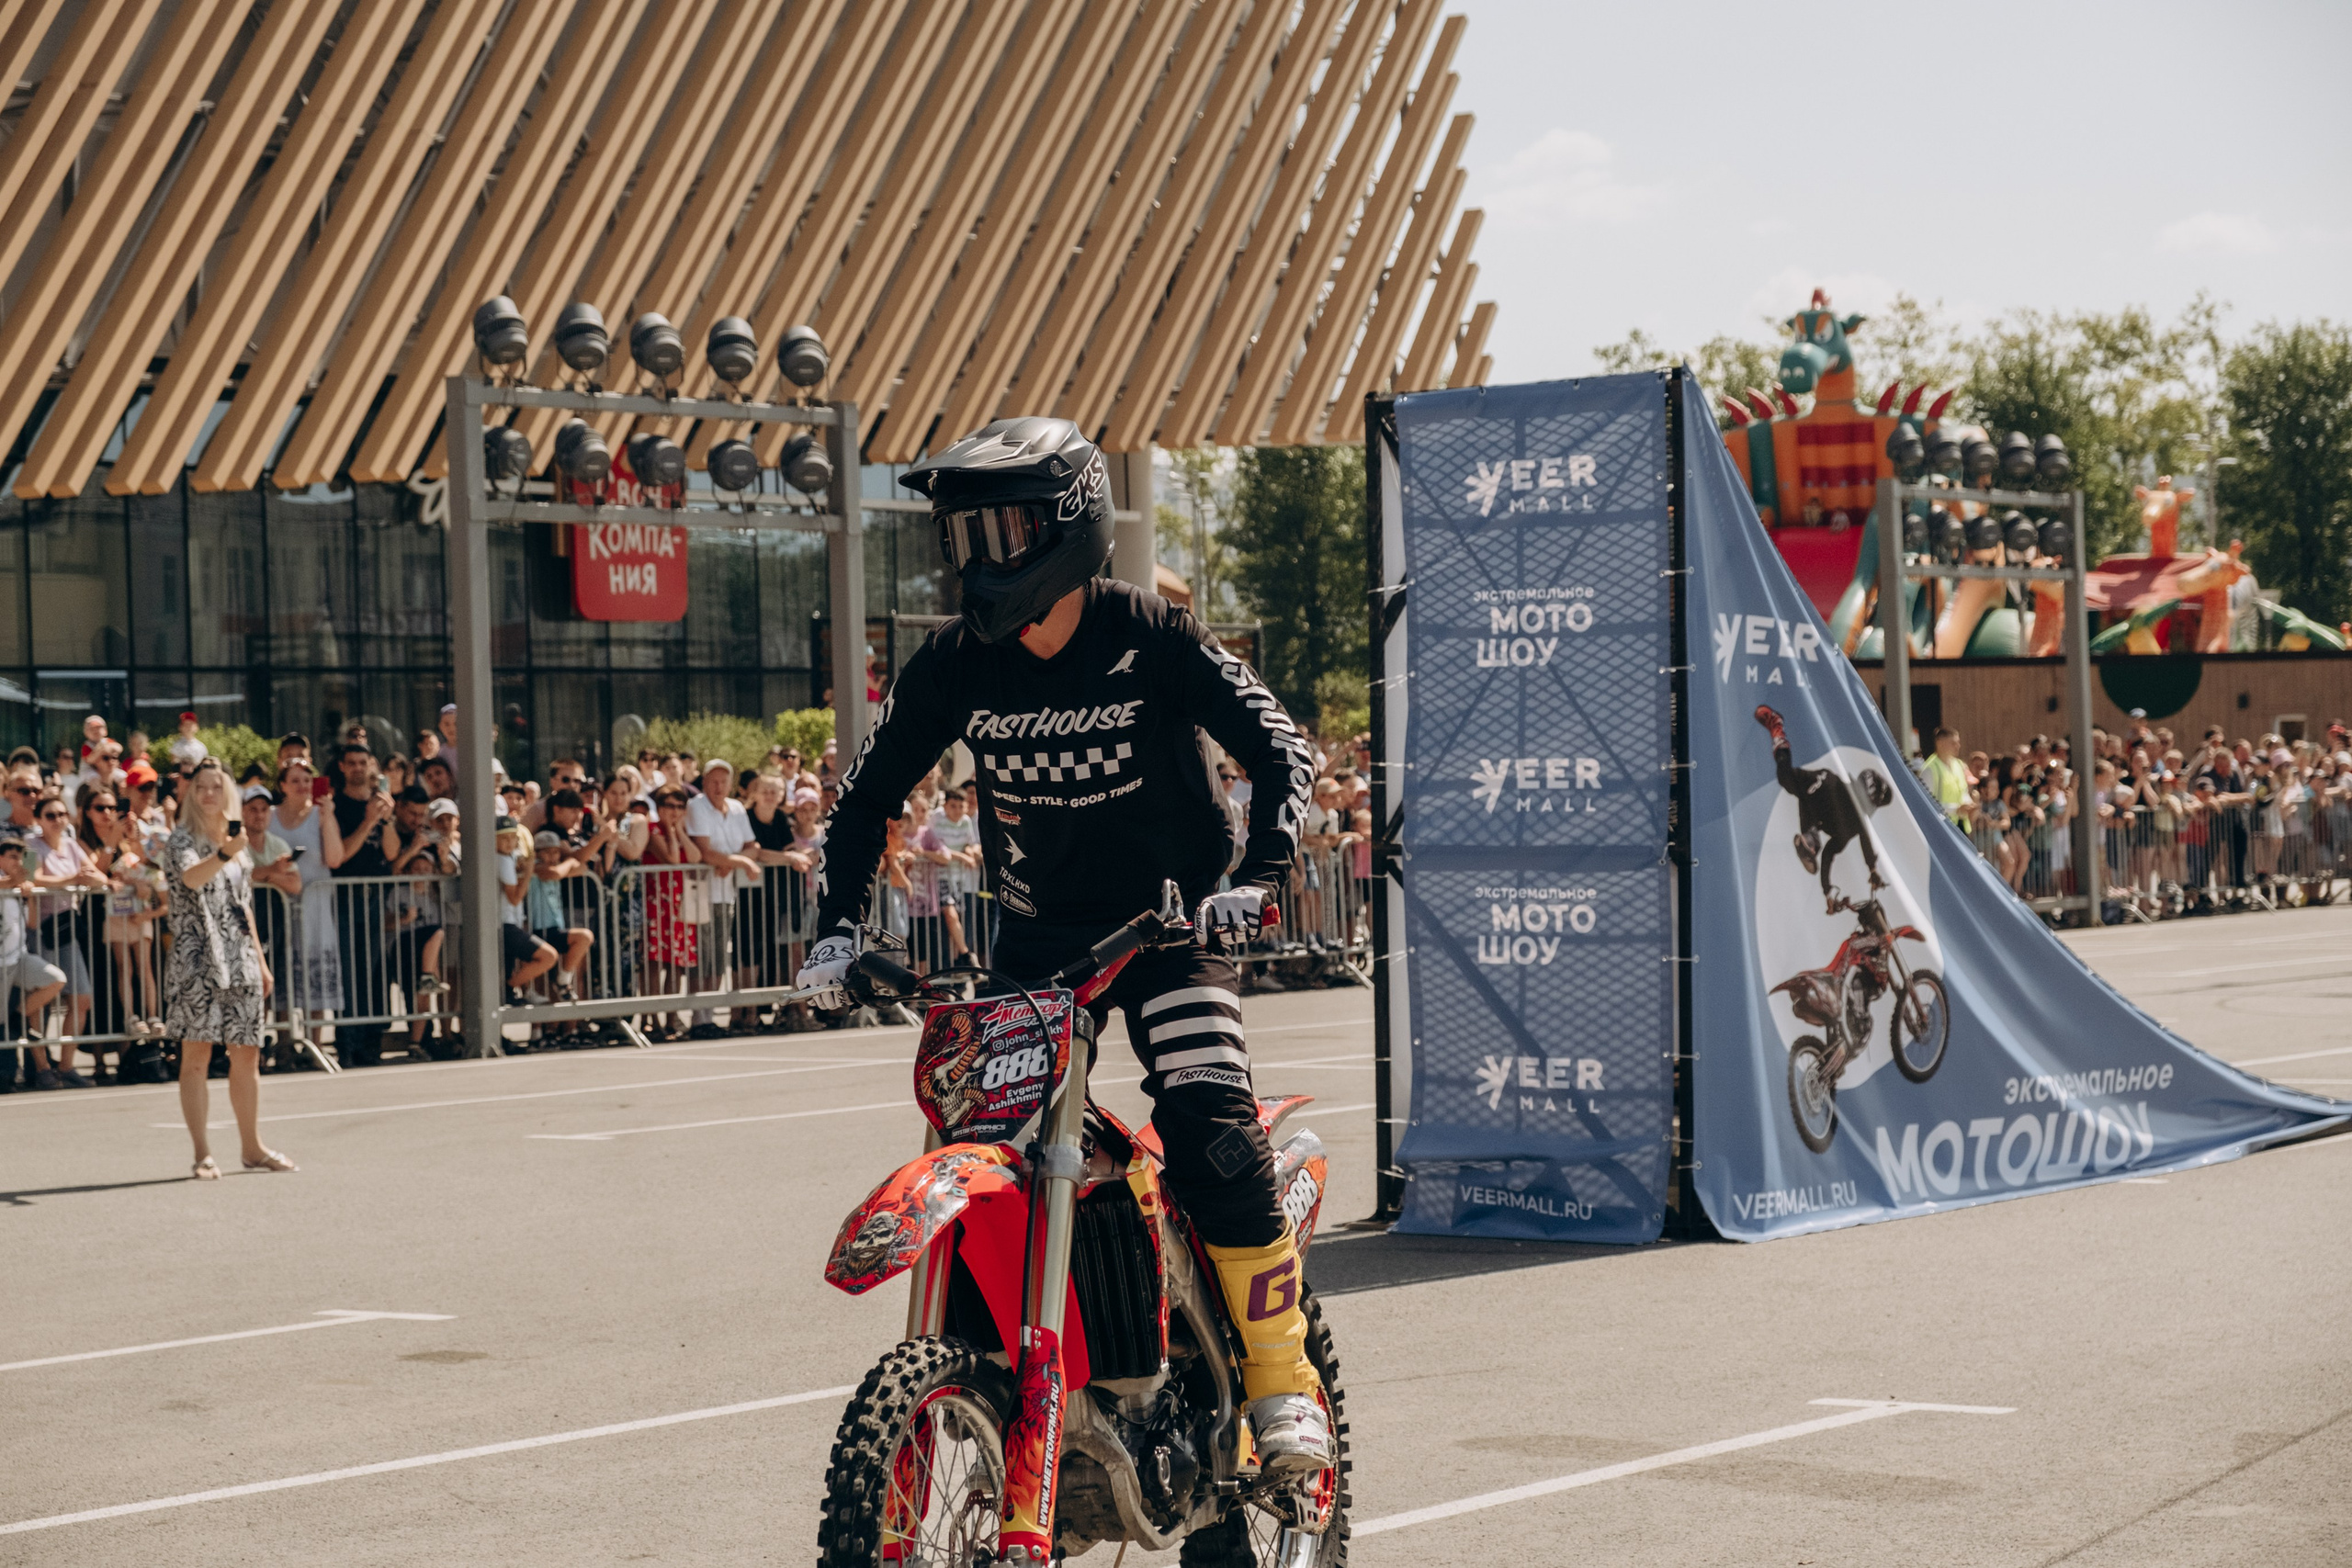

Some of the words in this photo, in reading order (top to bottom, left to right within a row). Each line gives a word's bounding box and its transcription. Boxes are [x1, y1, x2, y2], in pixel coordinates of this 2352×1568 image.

[1464, 454, 1599, 518] VEER
[1509, 493, 1594, 513] MALL
[608, 562, 658, 595] НИЯ
[1473, 586, 1595, 604] экстремальное
[1490, 602, 1594, 635] МОТО
[1476, 637, 1559, 668] ШОУ
[966, 699, 1145, 740] FASTHOUSE
[992, 789, 1022, 804] SPEED
[1030, 795, 1063, 807] STYLE
[1069, 792, 1106, 808] GOOD
[1110, 777, 1143, 799] TIMES
[1470, 758, 1602, 815] VEER
[1516, 797, 1597, 812] MALL
[1475, 886, 1598, 902] экстремальное
[1491, 903, 1597, 933] МОТО
[1478, 935, 1561, 965] ШОУ
[982, 1043, 1057, 1090] 888
[1176, 1067, 1246, 1085] FASTHOUSE
[1476, 1055, 1605, 1111] VEER
[988, 1091, 1042, 1112] Ashikhmin
[1006, 1082, 1045, 1100] Evgeny
[1520, 1096, 1600, 1113] MALL
[1875, 1101, 2154, 1201] МОТОШОУ
[1282, 1168, 1318, 1235] 888
[1460, 1184, 1592, 1221] VEERMALL.RU
[1733, 1179, 1858, 1220] VEERMALL.RU
[1247, 1256, 1296, 1322] G
[1039, 1382, 1059, 1526] WWW.METEORFMX.RU
